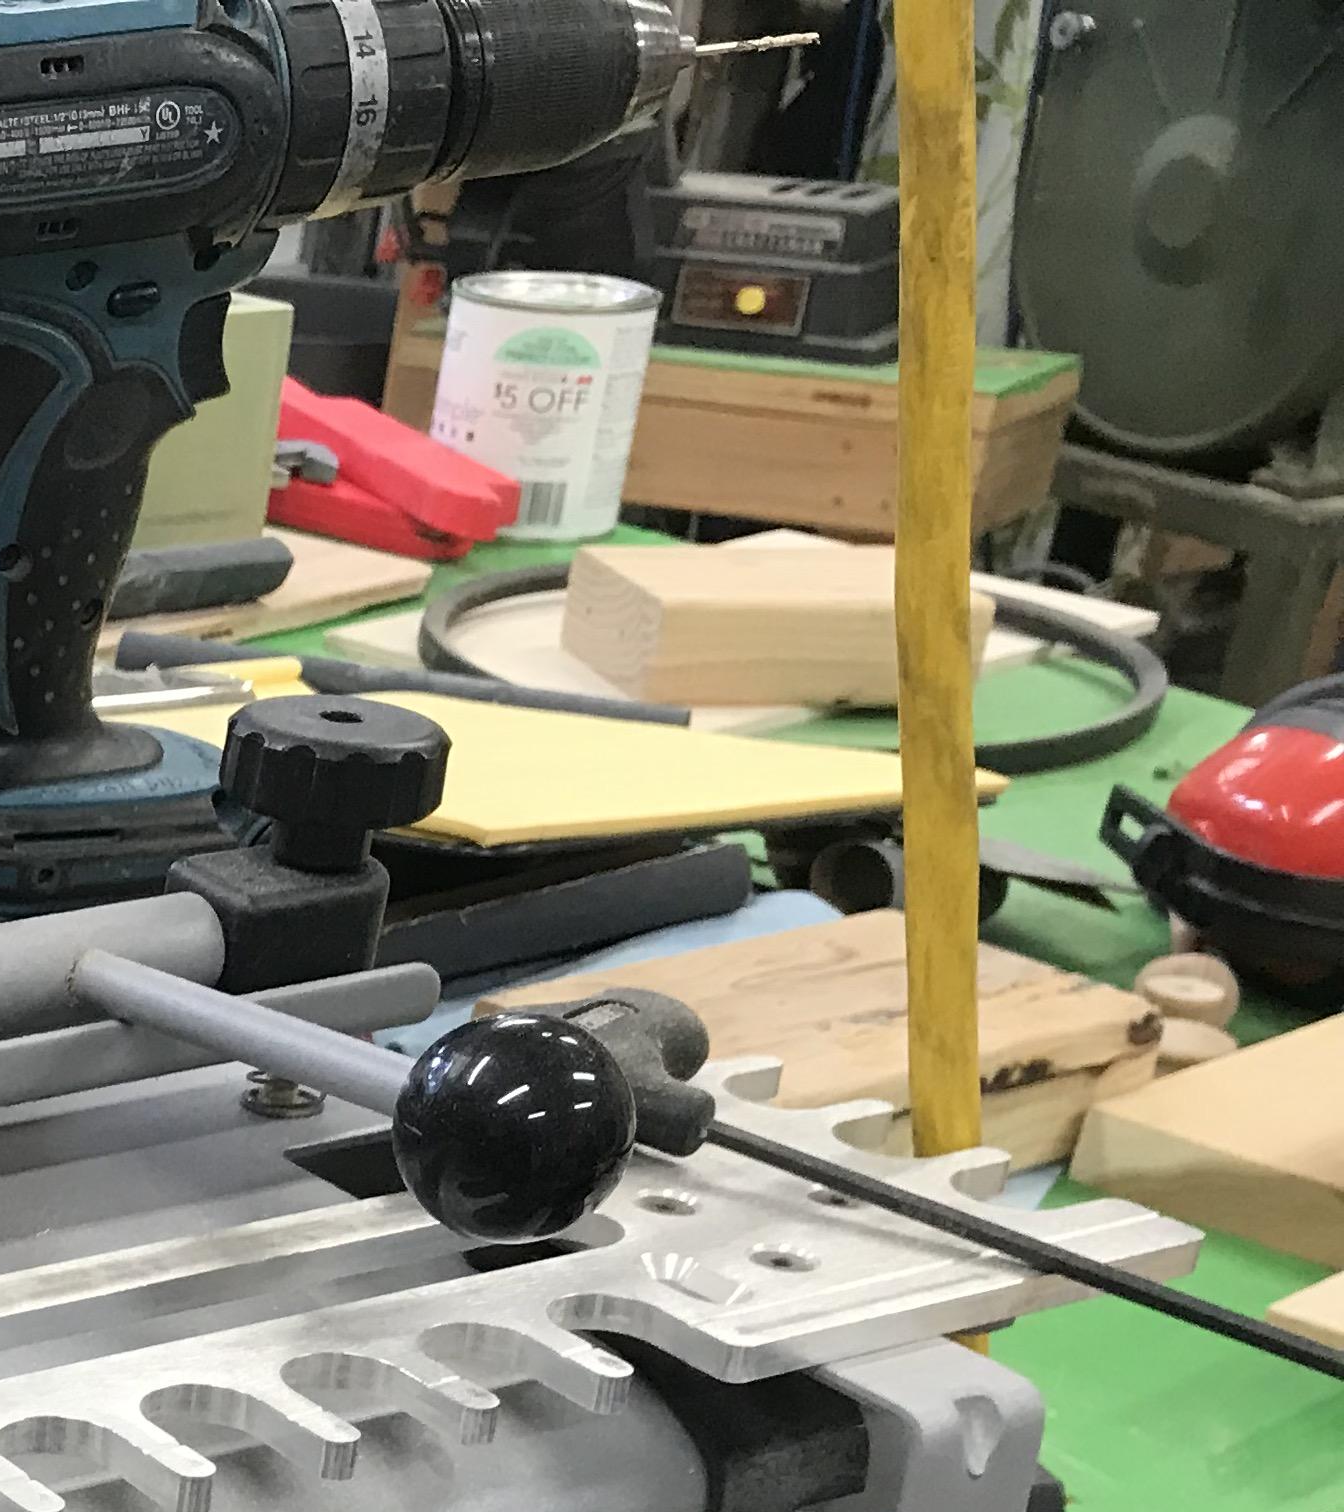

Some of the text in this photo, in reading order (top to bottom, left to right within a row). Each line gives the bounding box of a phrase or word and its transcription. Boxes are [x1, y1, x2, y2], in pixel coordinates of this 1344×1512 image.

[353, 29, 376, 59] 14
[355, 94, 378, 127] 16
[528, 387, 591, 413] OFF
